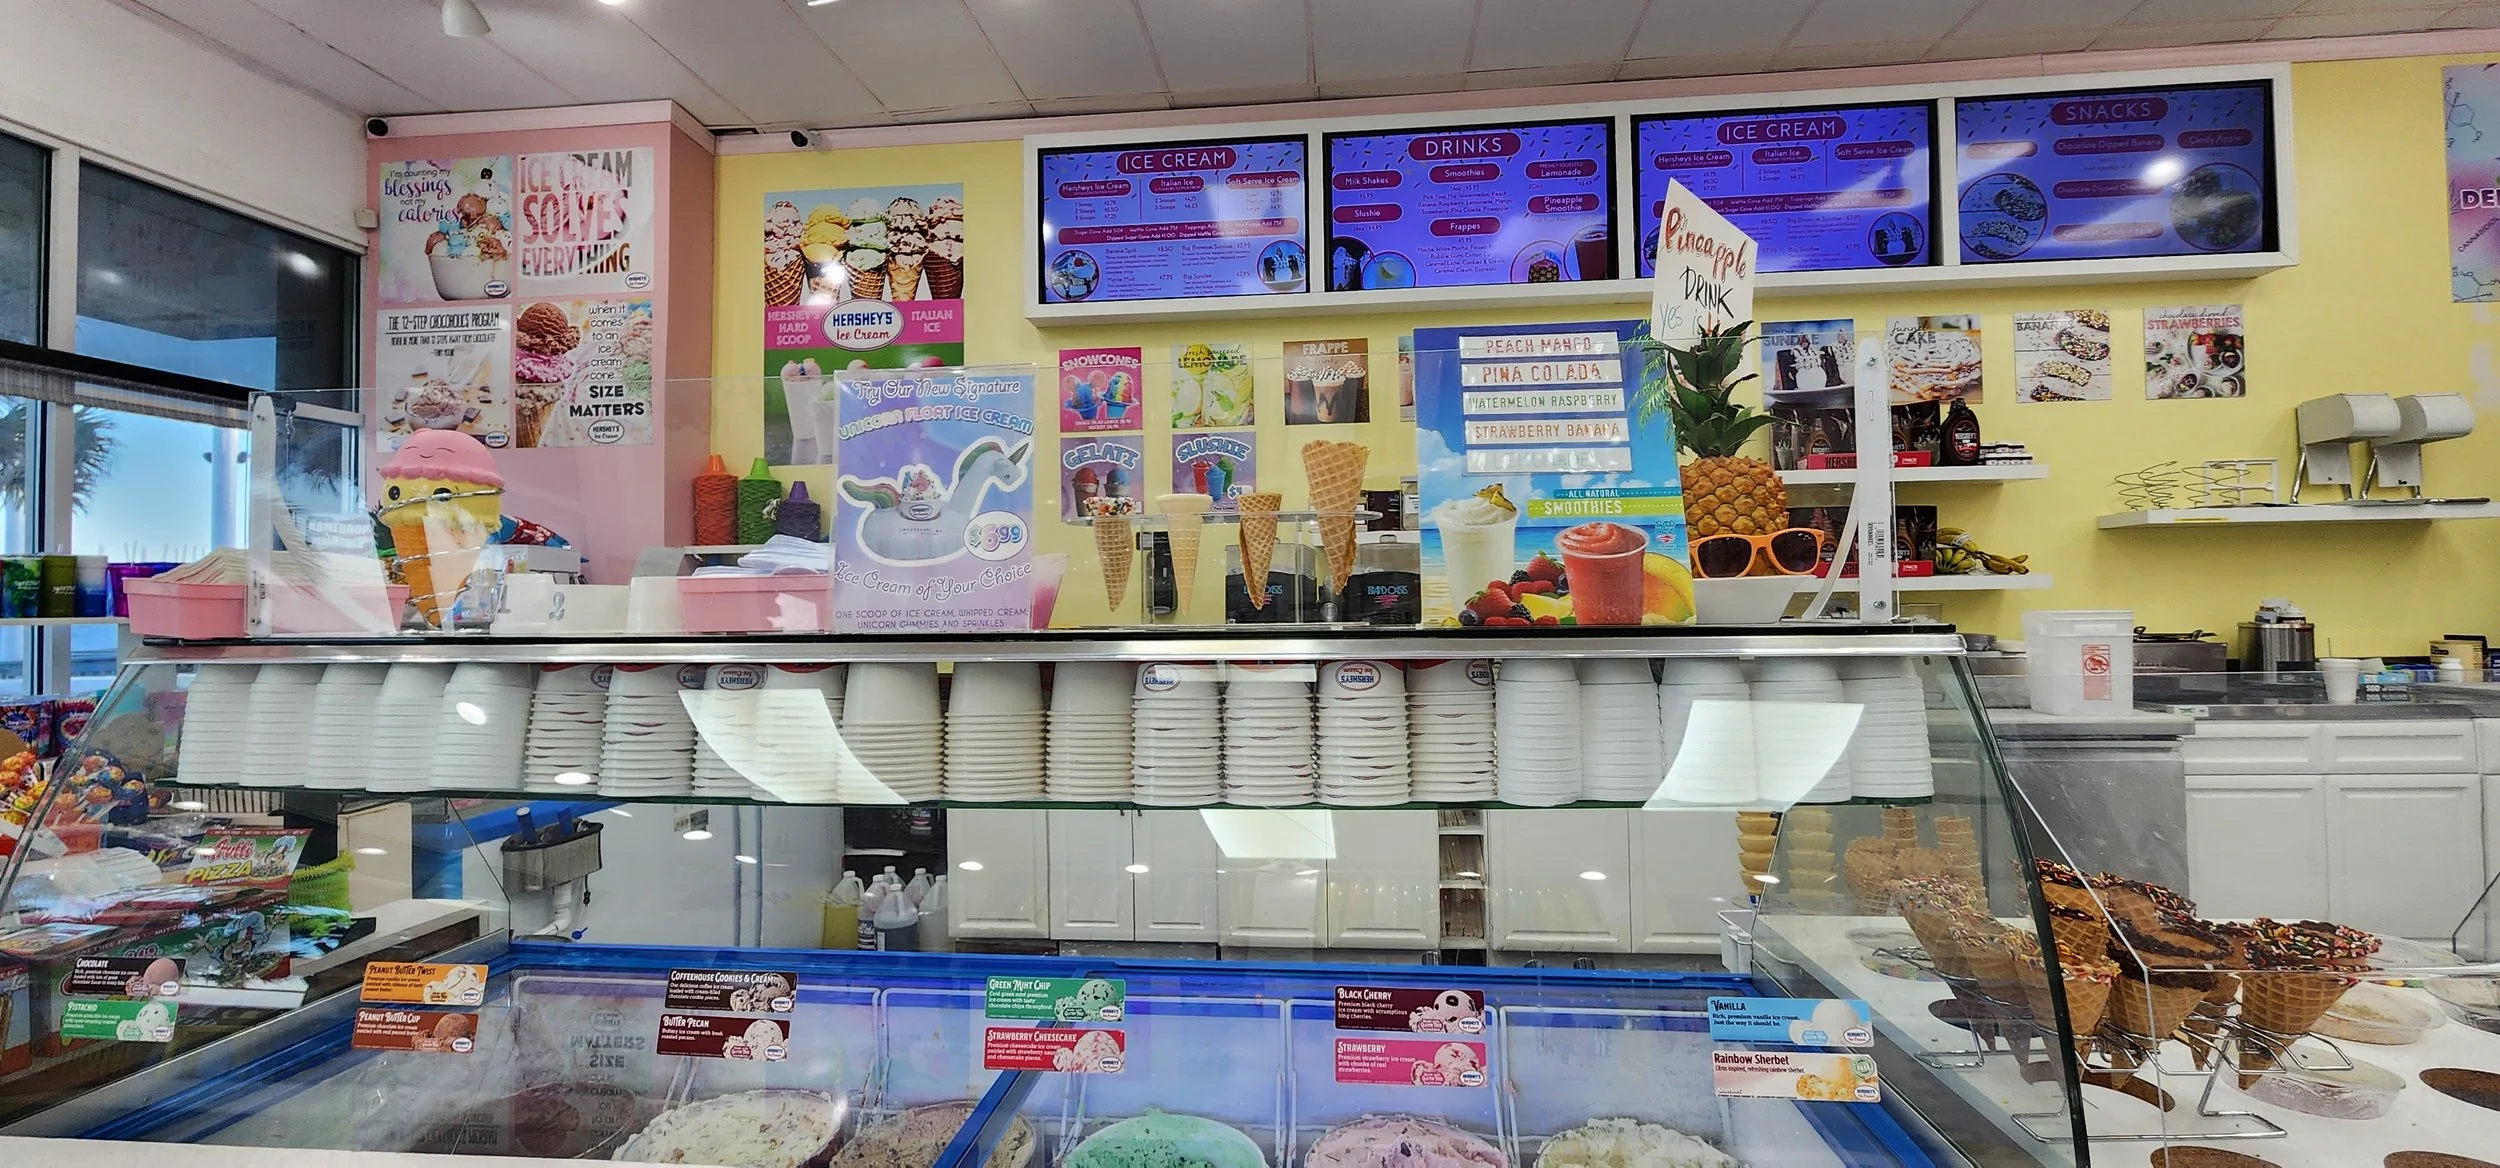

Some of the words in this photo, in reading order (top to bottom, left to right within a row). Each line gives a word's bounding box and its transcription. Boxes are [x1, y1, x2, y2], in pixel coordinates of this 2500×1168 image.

[2065, 102, 2151, 121] SNACKS
[1726, 125, 1758, 140] ICE
[1766, 120, 1836, 138] CREAM
[1425, 137, 1502, 156] DRINKS
[1658, 155, 1692, 164] Hersheys
[1706, 153, 1731, 161] Cream
[1764, 150, 1788, 158] Italian
[1124, 155, 1154, 170] ICE
[1161, 152, 1226, 169] CREAM
[404, 169, 438, 177] counting
[440, 169, 451, 177] my
[520, 157, 552, 193] ICE
[560, 150, 633, 190] CREAM
[1444, 169, 1485, 177] Smoothies
[1541, 168, 1582, 177] Lemonade
[1062, 183, 1093, 192] Hersheys
[1106, 182, 1129, 190] Cream
[1226, 178, 1241, 186] Soft
[1277, 175, 1300, 184] Cream
[384, 177, 452, 200] blessings
[400, 198, 413, 206] not
[414, 198, 427, 207] my
[1544, 196, 1583, 205] Pineapple
[2460, 188, 2500, 210] DE
[398, 204, 462, 223] calories
[1354, 209, 1381, 218] Slushie
[1545, 204, 1582, 213] Smoothie
[523, 189, 630, 244] SOLVES
[1450, 222, 1481, 232] Frappes
[1664, 207, 1748, 283] Pineapple
[522, 242, 630, 277] EVERYTHING
[1679, 265, 1735, 319] DRINK
[589, 305, 617, 315] when
[619, 304, 626, 314] it
[768, 310, 821, 322] HERSHEY'S
[911, 309, 953, 321] ITALIAN
[388, 316, 399, 330] THE
[402, 315, 428, 330] 12-STEP
[429, 313, 470, 329] CHOCOHOLICS
[471, 311, 500, 327] PROGRAM
[590, 319, 624, 328] comes
[832, 311, 894, 327] HERSHEY'S
[2147, 318, 2241, 330] STRAWBERRIES
[778, 322, 808, 333] HARD
[923, 322, 941, 333] ICE
[1889, 320, 1929, 336] funnel
[592, 332, 603, 341] to
[605, 332, 619, 340] an
[776, 334, 811, 346] SCOOP
[836, 329, 852, 341] Ice
[853, 328, 891, 340] Cream
[1764, 334, 1820, 347] SUNDAE
[1894, 331, 1937, 345] CAKE
[598, 344, 612, 353] ice
[1302, 341, 1349, 355] FRAPPE
[1486, 339, 1535, 353] PEACH
[1541, 337, 1592, 353] MANGO
[590, 358, 622, 367] cream
[1062, 353, 1140, 371] SNOWCONES
[1482, 366, 1523, 383] PINA
[1531, 363, 1602, 382] COLADA
[589, 385, 624, 399] SIZE
[853, 379, 880, 406] Try
[883, 377, 912, 398] Our
[915, 377, 950, 397] New
[953, 377, 1021, 401] Signature
[1469, 395, 1545, 409] WATERMELON
[1551, 394, 1617, 407] RASPBERRY
[569, 402, 645, 418] MATTERS
[838, 409, 903, 441] UNICORN
[904, 405, 953, 423] FLOAT
[955, 406, 979, 421] ICE
[982, 409, 1034, 435] CREAM
[1475, 424, 1560, 438] STRAWBERRY
[1567, 422, 1620, 437] BANANA
[1064, 443, 1140, 469] GELATI
[1176, 437, 1251, 463] SLUSHIE
[1568, 490, 1584, 498] ALL
[1585, 489, 1619, 498] NATURAL
[1544, 499, 1623, 515] SMOOTHIES
[835, 562, 860, 583] Ice
[862, 573, 911, 596] Cream
[916, 580, 936, 602] of
[936, 575, 976, 601] Your
[979, 562, 1033, 589] Choice
[835, 611, 853, 619] ONE
[856, 610, 888, 619] SCOOP
[892, 610, 903, 618] OF
[906, 609, 920, 617] ICE
[923, 609, 956, 618] CREAM,
[958, 608, 994, 617] WHIPPED
[858, 620, 896, 629] UNICORN
[900, 619, 939, 629] GUMMIES
[943, 619, 959, 628] AND
[962, 619, 1005, 628] SPRINKLES
[1341, 675, 1375, 684] HERSHEY'S
[187, 860, 253, 883] PIZZA
[76, 958, 109, 968] CHOCOLATE
[369, 965, 394, 975] PEANUT
[395, 965, 416, 975] BUTTER
[417, 966, 436, 977] TWIST
[670, 970, 714, 982] COFFEEHOUSE
[715, 972, 743, 983] COOKIES
[743, 974, 751, 983] &
[989, 979, 1012, 990] GREEN
[1012, 980, 1033, 991] MINT
[1033, 980, 1051, 990] CHIP
[1337, 987, 1362, 999] BLACK
[1363, 989, 1392, 1001] CHERRY
[68, 1001, 98, 1012] PISTACHIO
[1711, 1000, 1746, 1011] VANILLA
[359, 1011, 384, 1022] PEANUT
[385, 1011, 407, 1023] BUTTER
[407, 1013, 421, 1023] CUP
[662, 1015, 686, 1027] BUTTER
[687, 1018, 710, 1028] PECAN
[987, 1030, 1033, 1042] STRAWBERRY
[1034, 1031, 1077, 1042] CHEESECAKE
[1337, 1041, 1386, 1054] STRAWBERRY
[1714, 1053, 1753, 1065] Rainbow
[1755, 1054, 1790, 1066] Sherbet
[1747, 1066, 1769, 1074] refreshing
